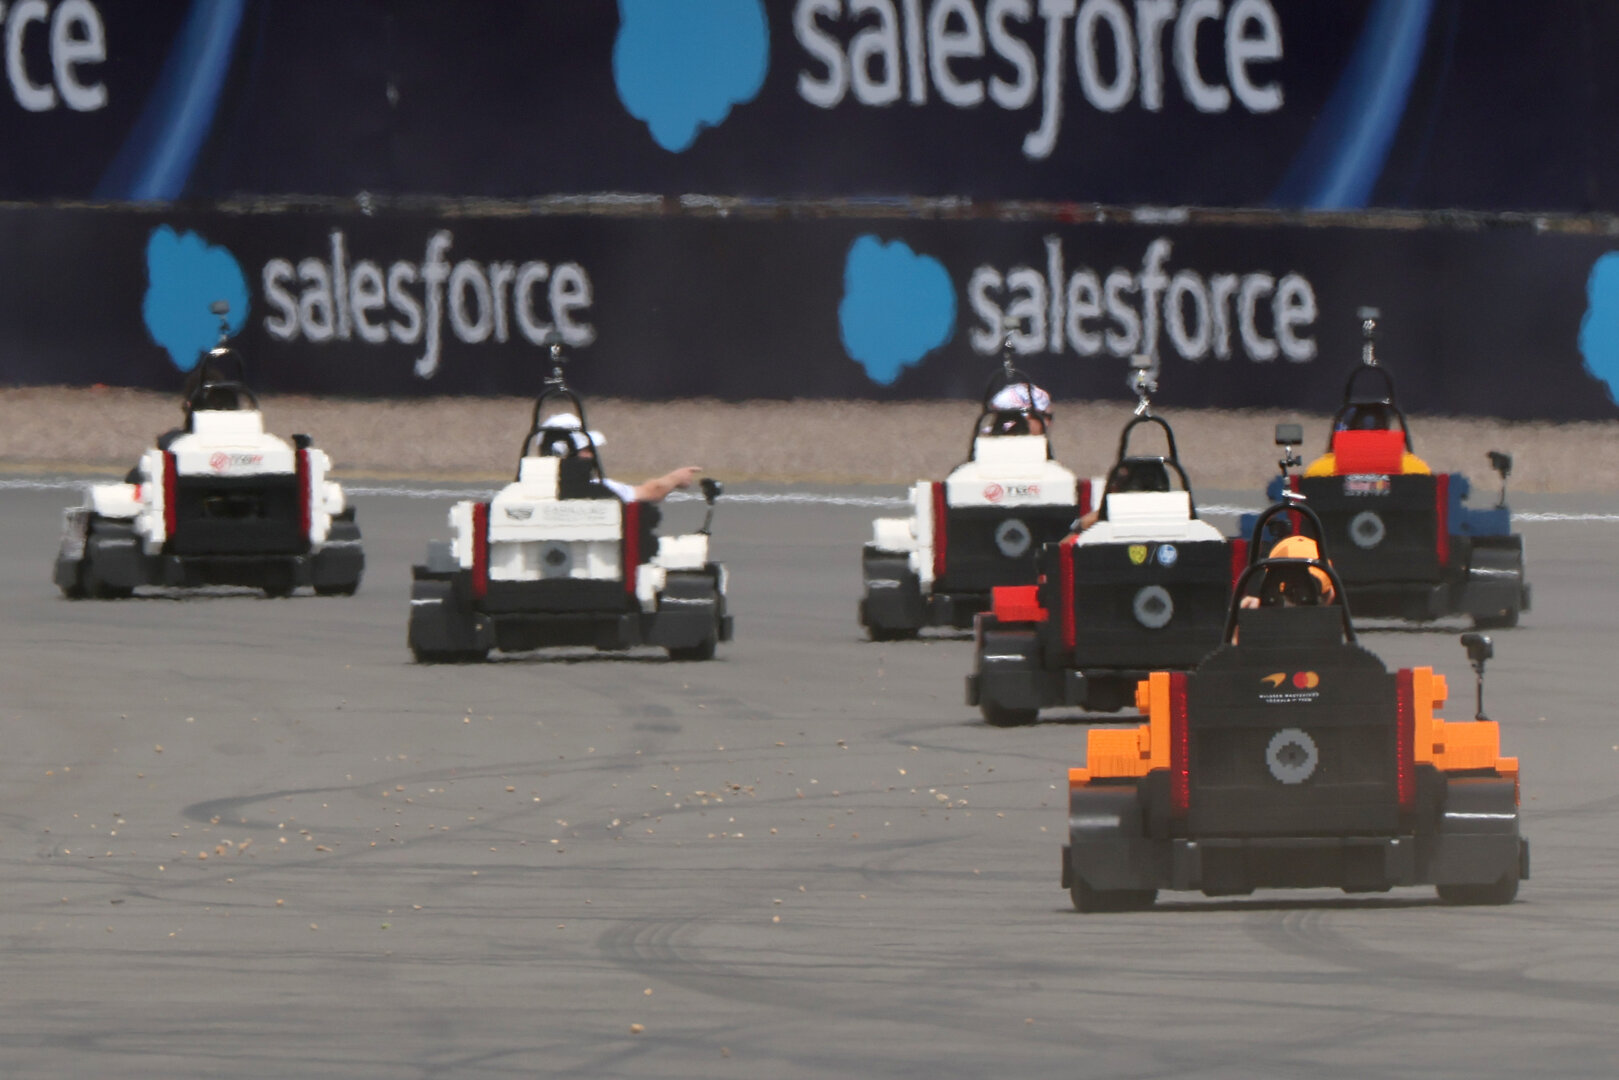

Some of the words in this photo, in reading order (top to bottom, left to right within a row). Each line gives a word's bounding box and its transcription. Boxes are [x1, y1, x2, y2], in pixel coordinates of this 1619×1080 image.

[0, 0, 108, 112] ce
[794, 0, 1285, 158] salesforce
[262, 229, 596, 378] salesforce
[967, 234, 1318, 391] salesforce
